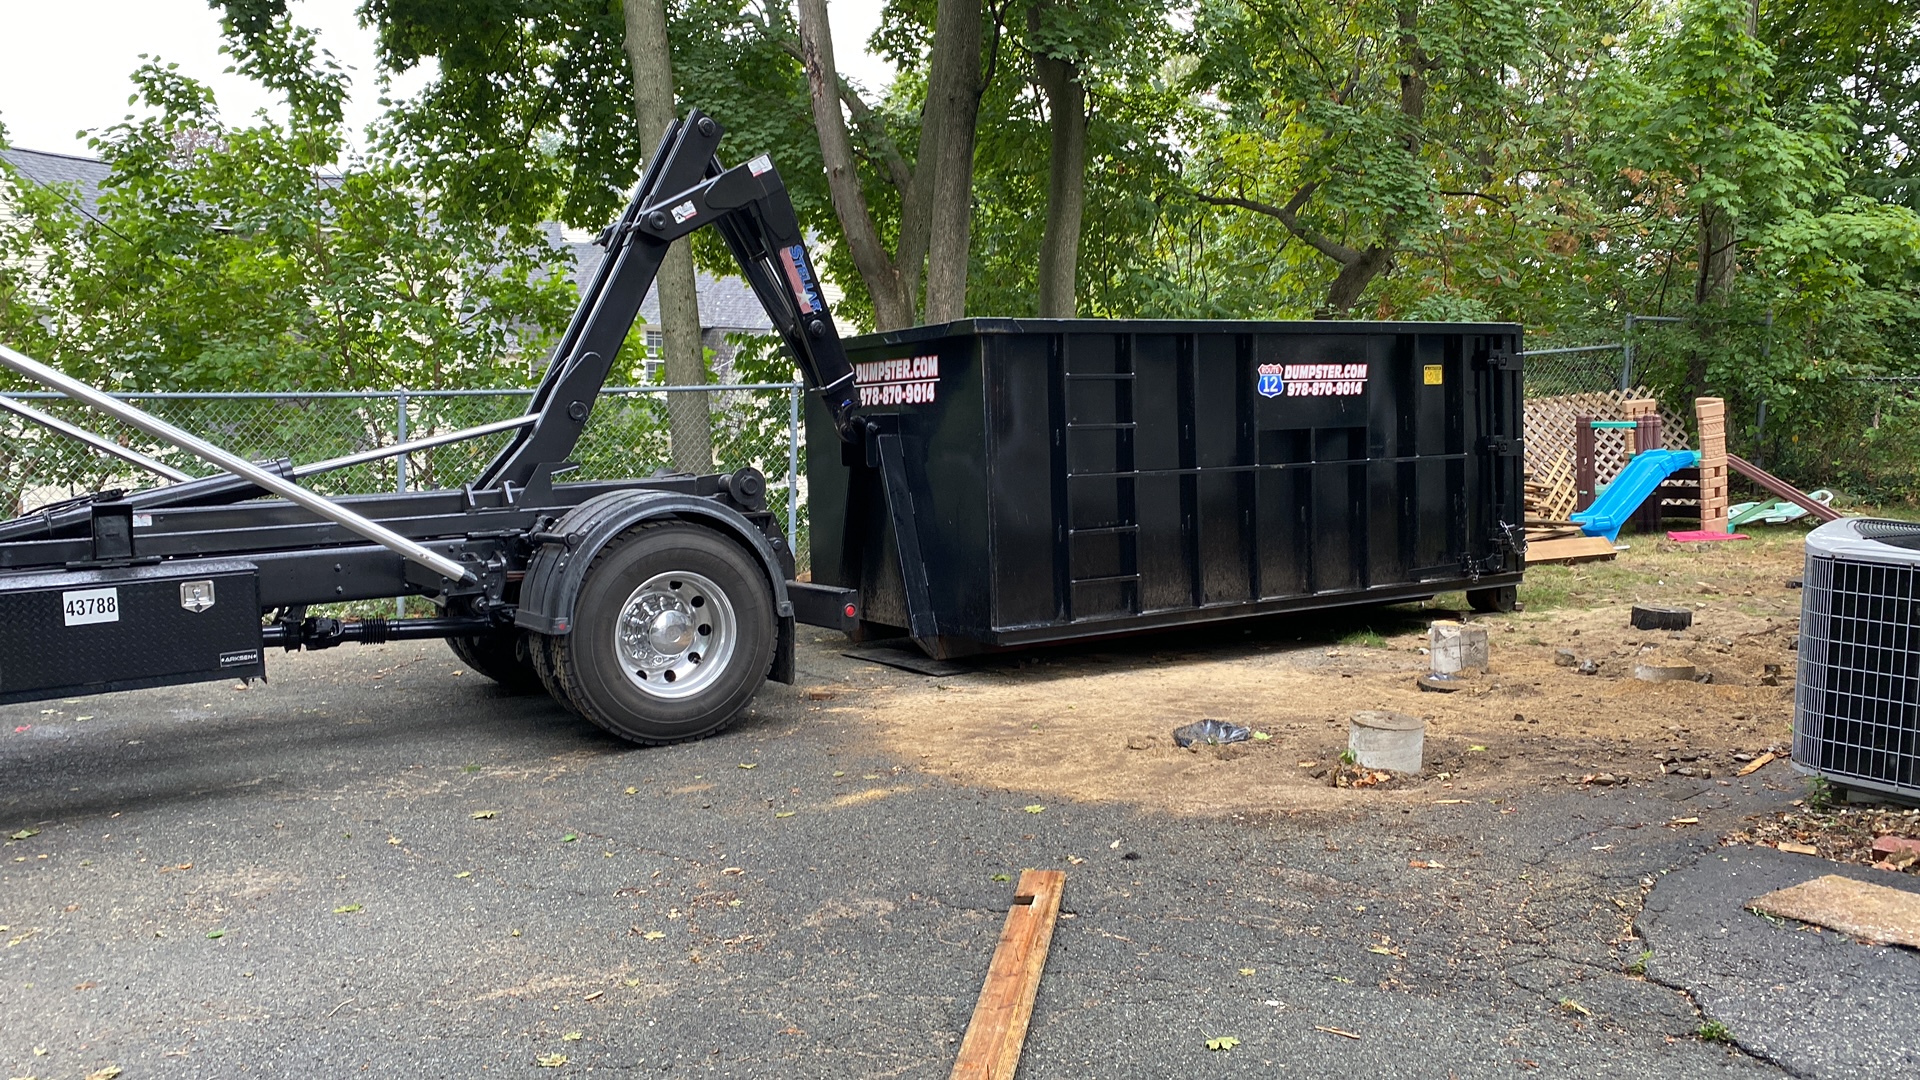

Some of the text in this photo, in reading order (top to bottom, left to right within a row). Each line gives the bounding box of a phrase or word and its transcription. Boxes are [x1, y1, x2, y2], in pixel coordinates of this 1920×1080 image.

[789, 244, 822, 314] STELLAR
[856, 355, 939, 384] DUMPSTER.COM
[1261, 366, 1281, 375] ROUTE
[1284, 364, 1368, 380] DUMPSTER.COM
[1263, 376, 1279, 393] 12
[66, 596, 116, 617] 43788
